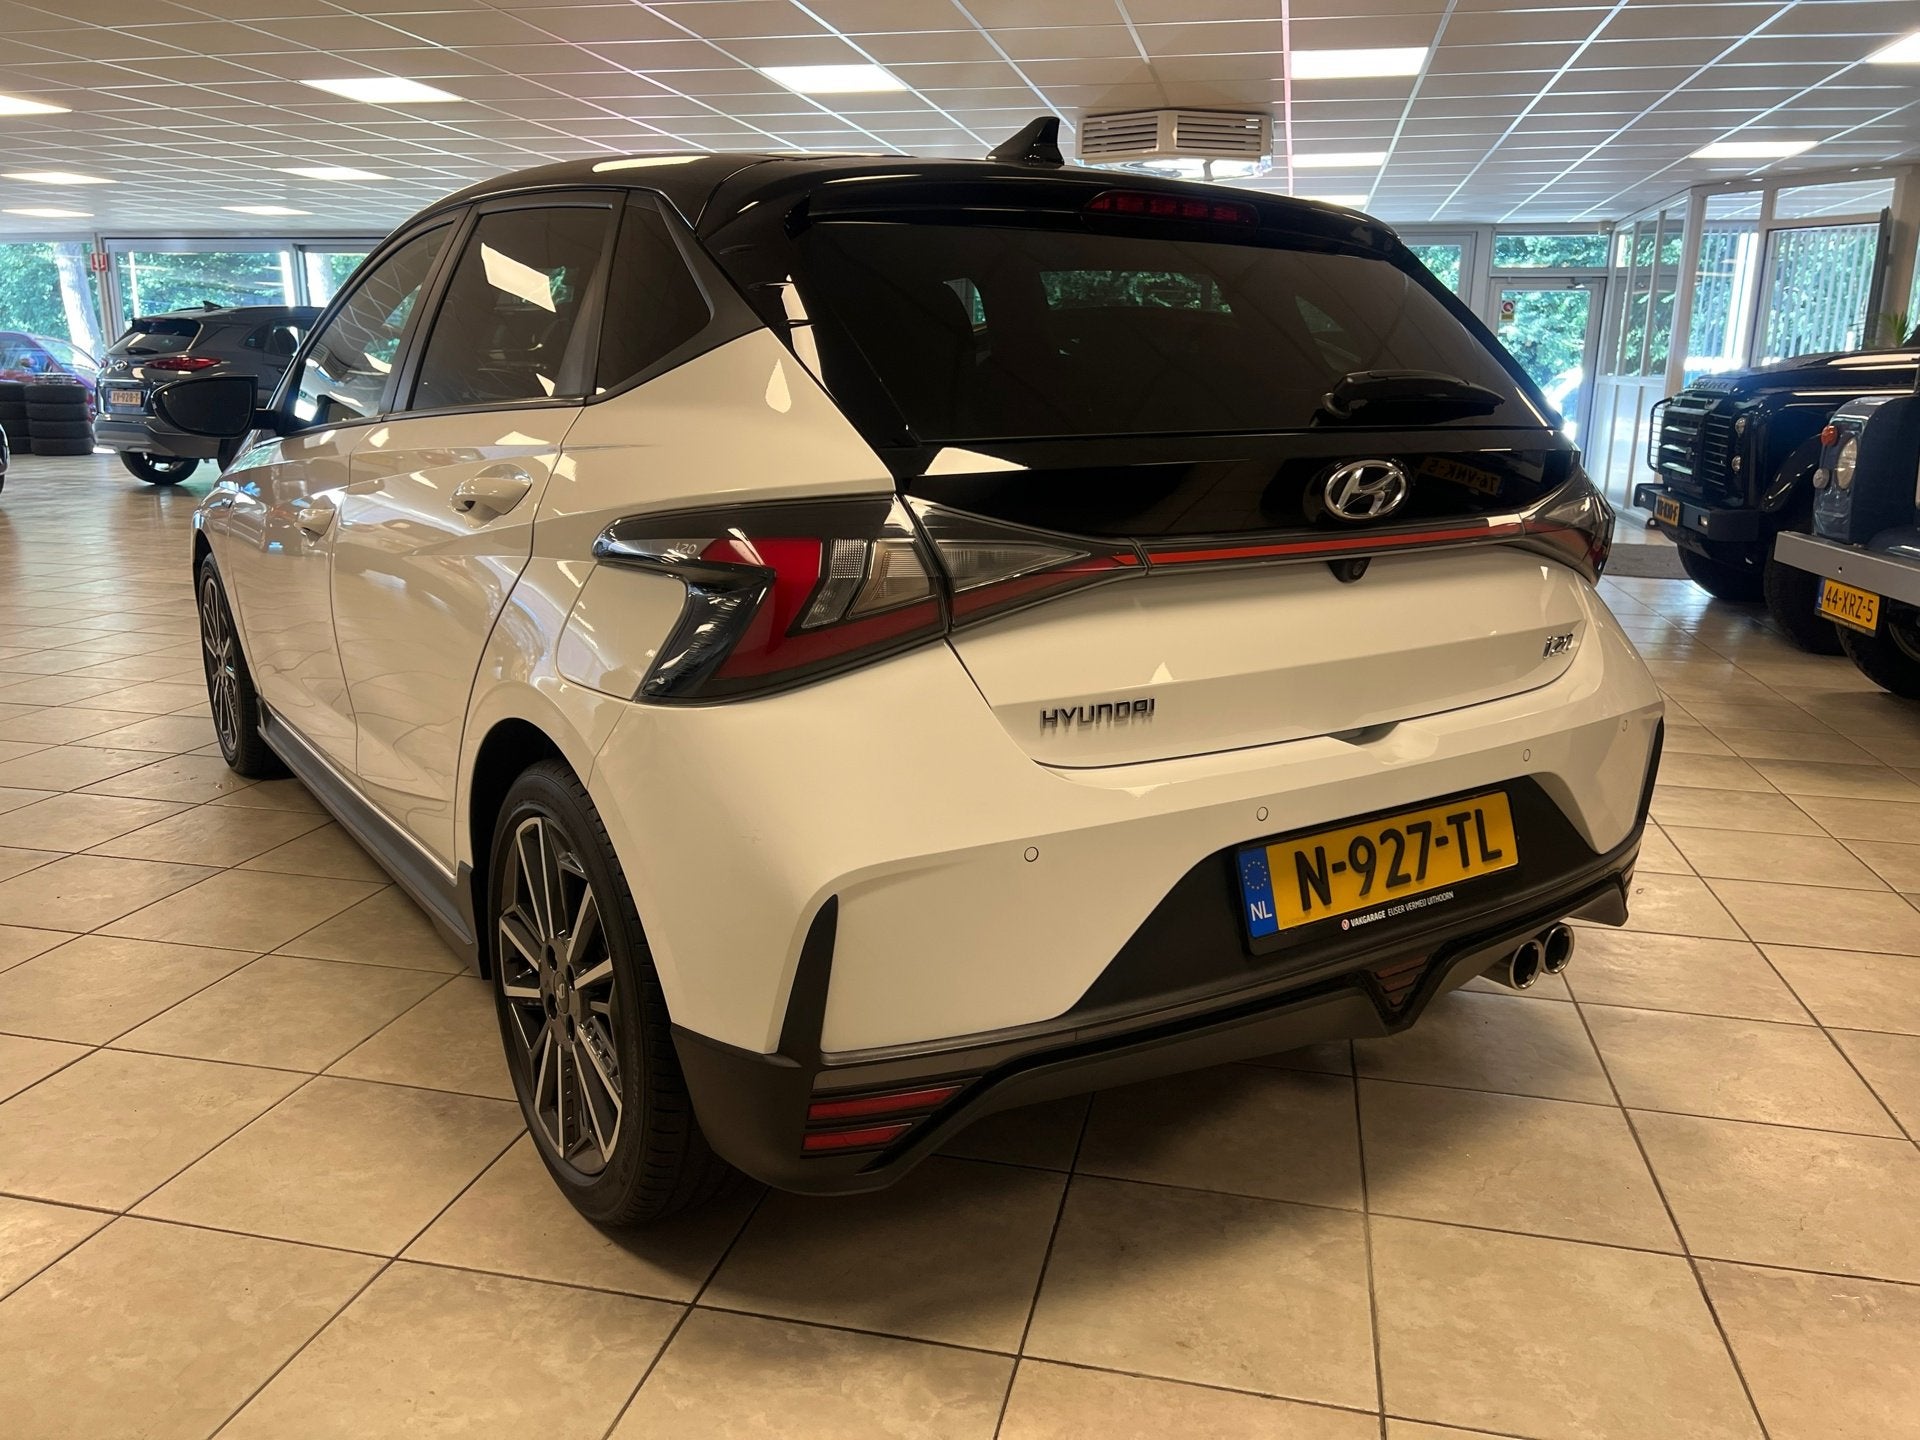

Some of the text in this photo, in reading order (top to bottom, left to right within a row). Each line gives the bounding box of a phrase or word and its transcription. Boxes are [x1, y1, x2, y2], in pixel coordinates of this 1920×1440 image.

[1825, 586, 1874, 622] 44-XRZ-5
[1040, 698, 1155, 730] HYUNDAI
[1294, 808, 1504, 911] N-927-TL
[1250, 900, 1273, 922] NL
[1350, 910, 1386, 927] VAKGARAGE
